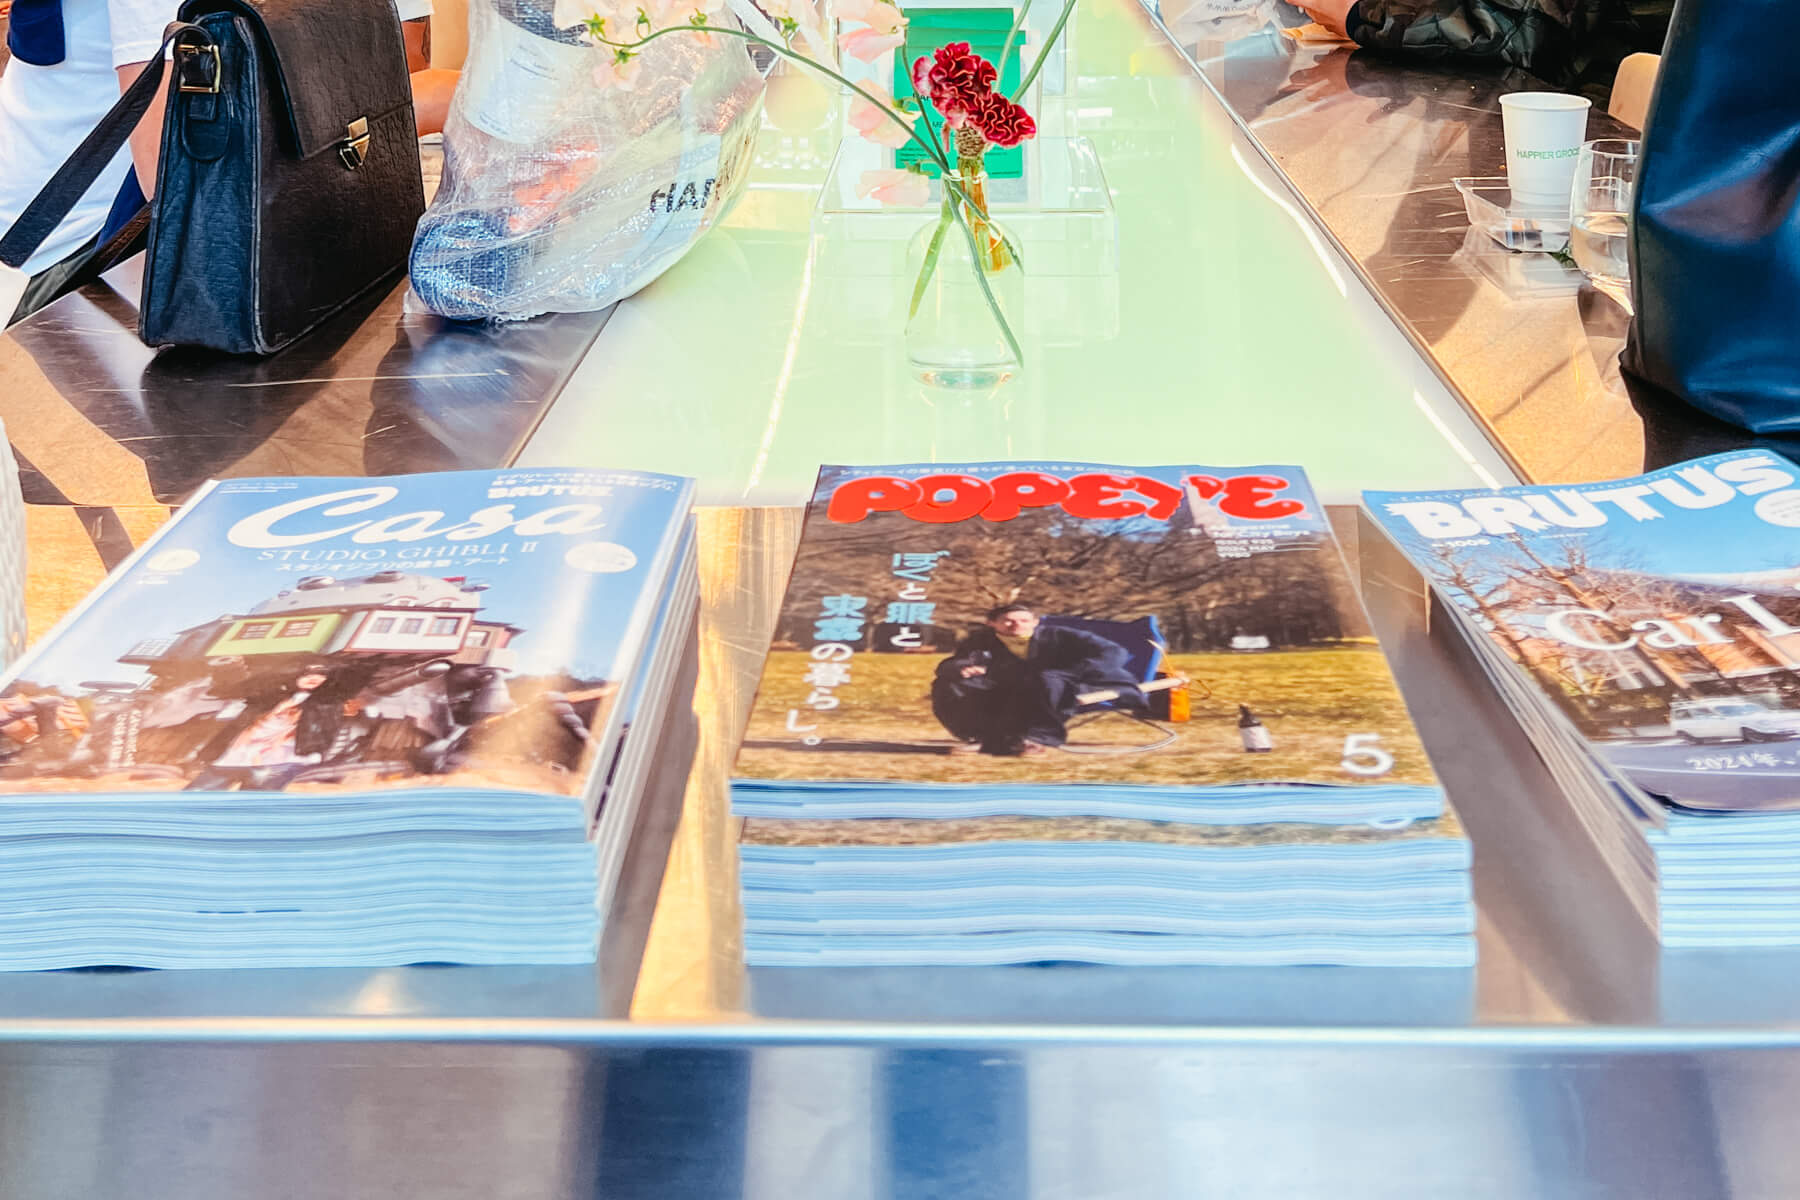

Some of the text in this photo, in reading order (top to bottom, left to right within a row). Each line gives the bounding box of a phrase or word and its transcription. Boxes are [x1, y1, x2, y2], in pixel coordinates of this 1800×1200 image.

[1516, 149, 1554, 160] HAPPIER
[227, 486, 607, 549] Casa
[827, 472, 1305, 523] POPEYE
[1381, 456, 1795, 539] BRUTUS
[257, 550, 387, 561] STUDIO
[397, 543, 511, 559] GHIBLI
[1545, 606, 1735, 651] Car
[1340, 732, 1395, 776] 5
